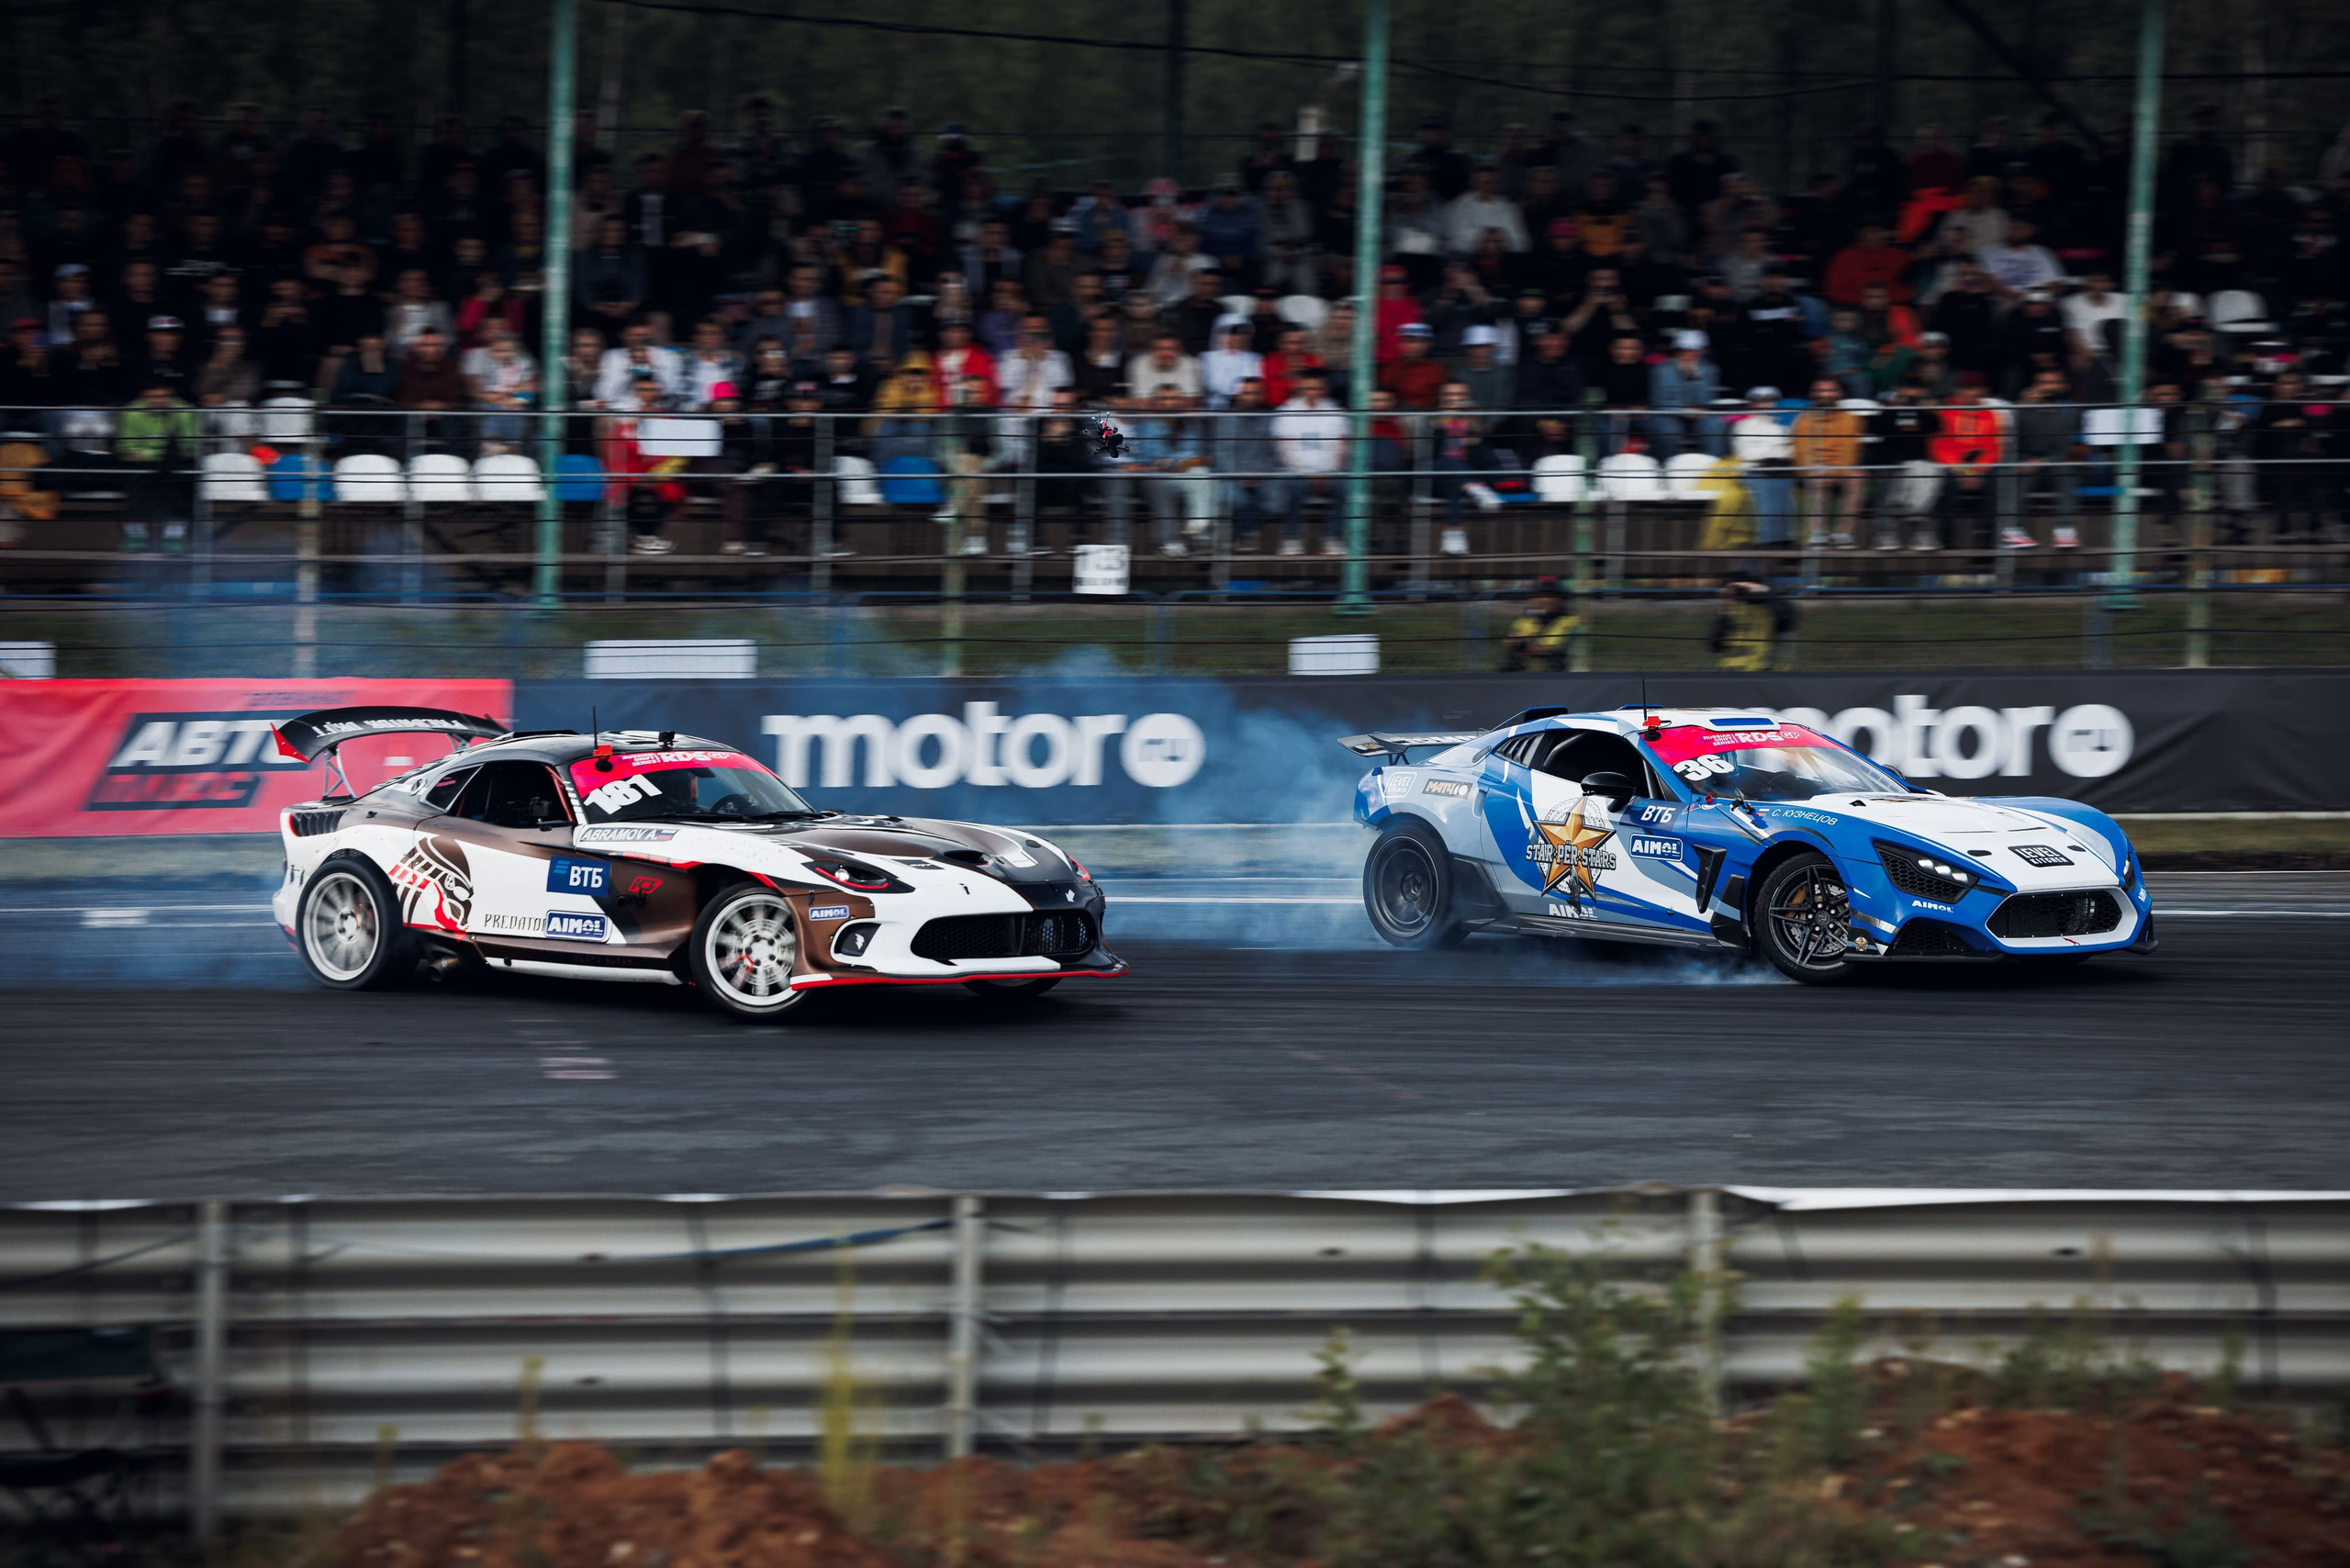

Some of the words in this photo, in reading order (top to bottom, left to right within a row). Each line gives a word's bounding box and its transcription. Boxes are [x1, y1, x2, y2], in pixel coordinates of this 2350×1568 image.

[761, 700, 1128, 789] motor
[1734, 731, 1784, 744] RDS
[657, 752, 711, 763] RDS
[1673, 754, 1735, 781] 36
[1389, 776, 1412, 787] LEVEL
[583, 774, 663, 815] 181
[1640, 805, 1676, 823] ВТБ
[1783, 809, 1839, 825] КУЗНЕЦОВ
[582, 829, 648, 841] ABRAMOV
[1632, 839, 1680, 857] AIMOL
[2015, 847, 2060, 858] LEVEL
[1526, 844, 1554, 861] STAR
[1582, 846, 1617, 870] STARS
[2030, 857, 2068, 865] KITCHEN
[569, 866, 603, 888] ВТБ
[811, 909, 847, 918] AIMOL
[1912, 900, 1952, 913] AIMOL
[547, 916, 604, 935] AIMOL
